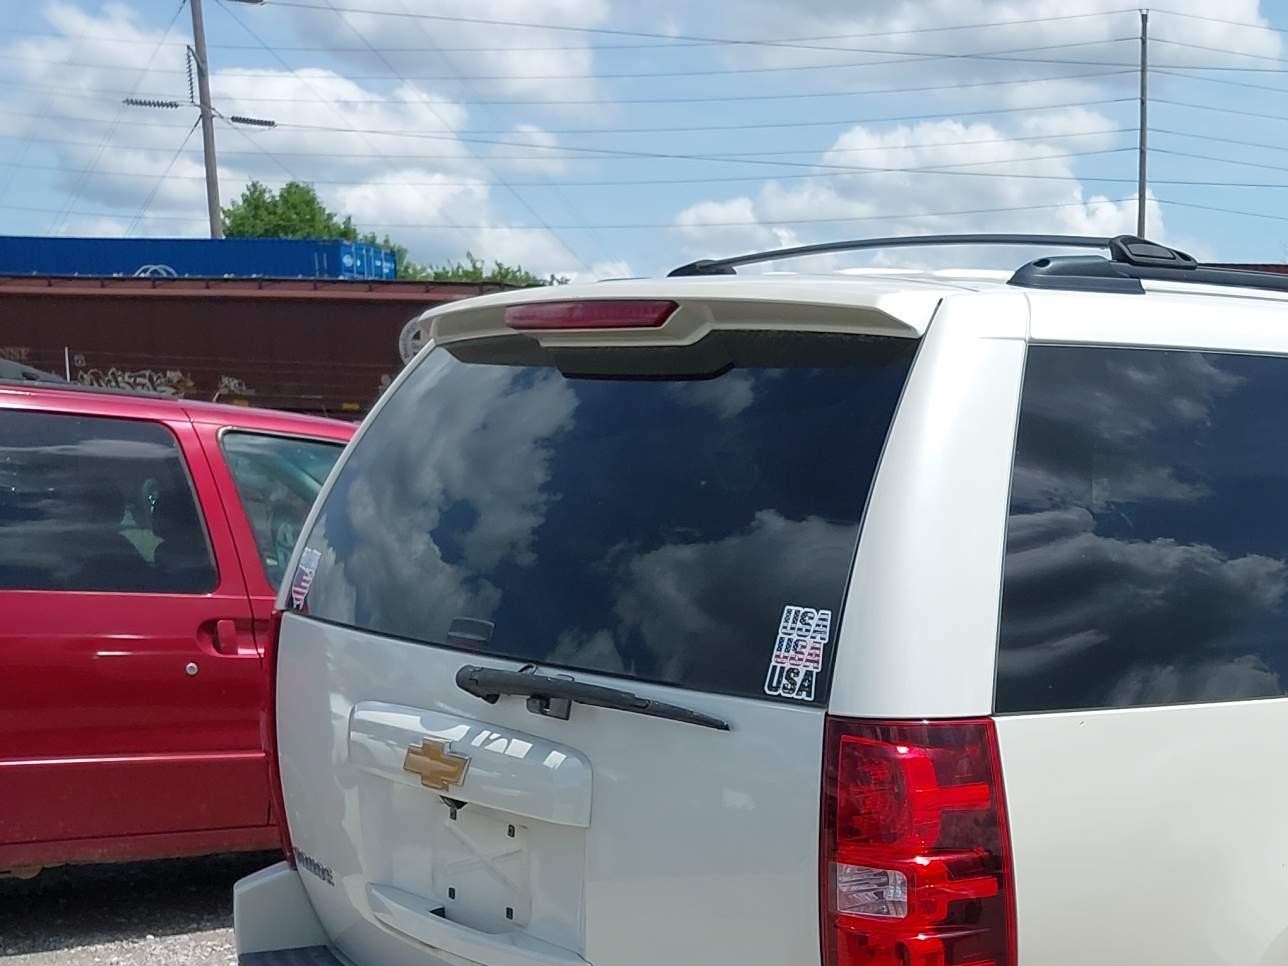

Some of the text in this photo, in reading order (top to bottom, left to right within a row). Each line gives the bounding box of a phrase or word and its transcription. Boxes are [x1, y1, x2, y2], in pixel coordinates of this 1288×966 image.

[780, 607, 830, 642] USA
[773, 636, 822, 670] USA
[766, 664, 815, 699] USA
